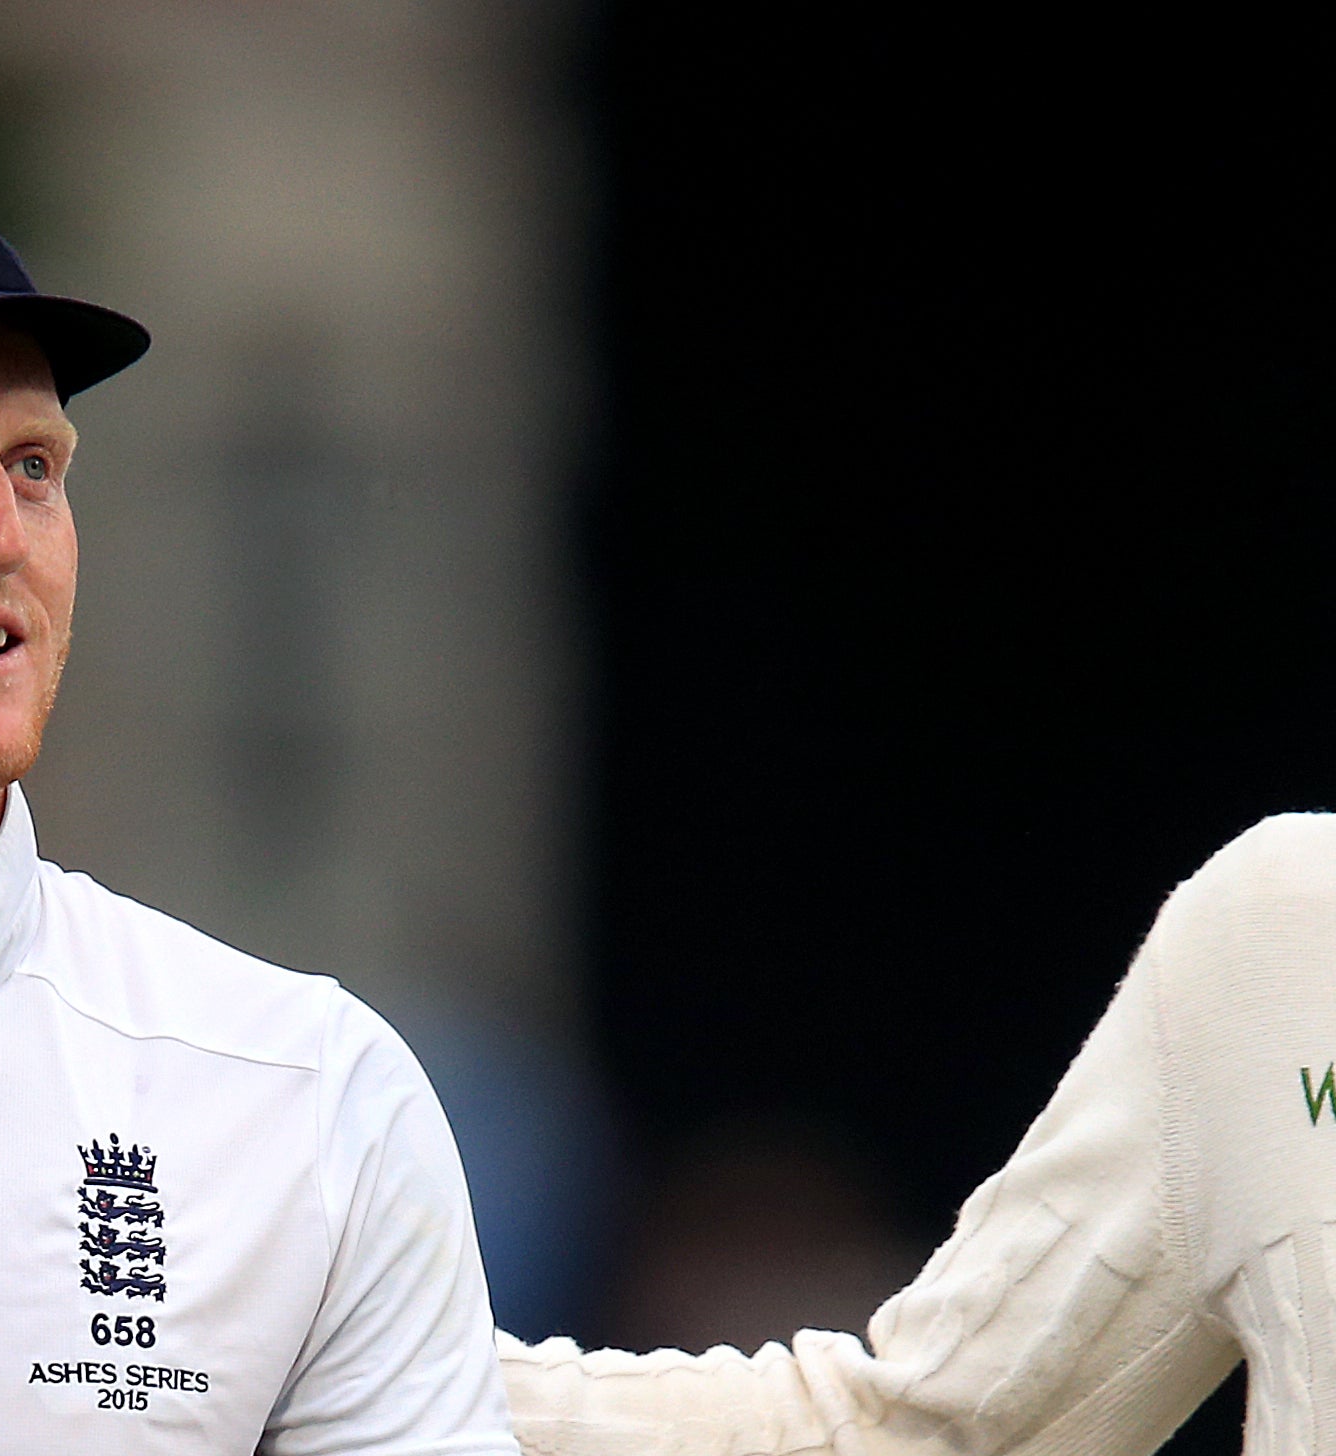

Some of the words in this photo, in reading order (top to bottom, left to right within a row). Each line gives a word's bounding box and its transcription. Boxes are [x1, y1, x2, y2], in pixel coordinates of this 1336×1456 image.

[91, 1313, 156, 1348] 658
[28, 1362, 118, 1384] ASHES
[125, 1364, 210, 1392] SERIES
[97, 1388, 149, 1411] 2015
